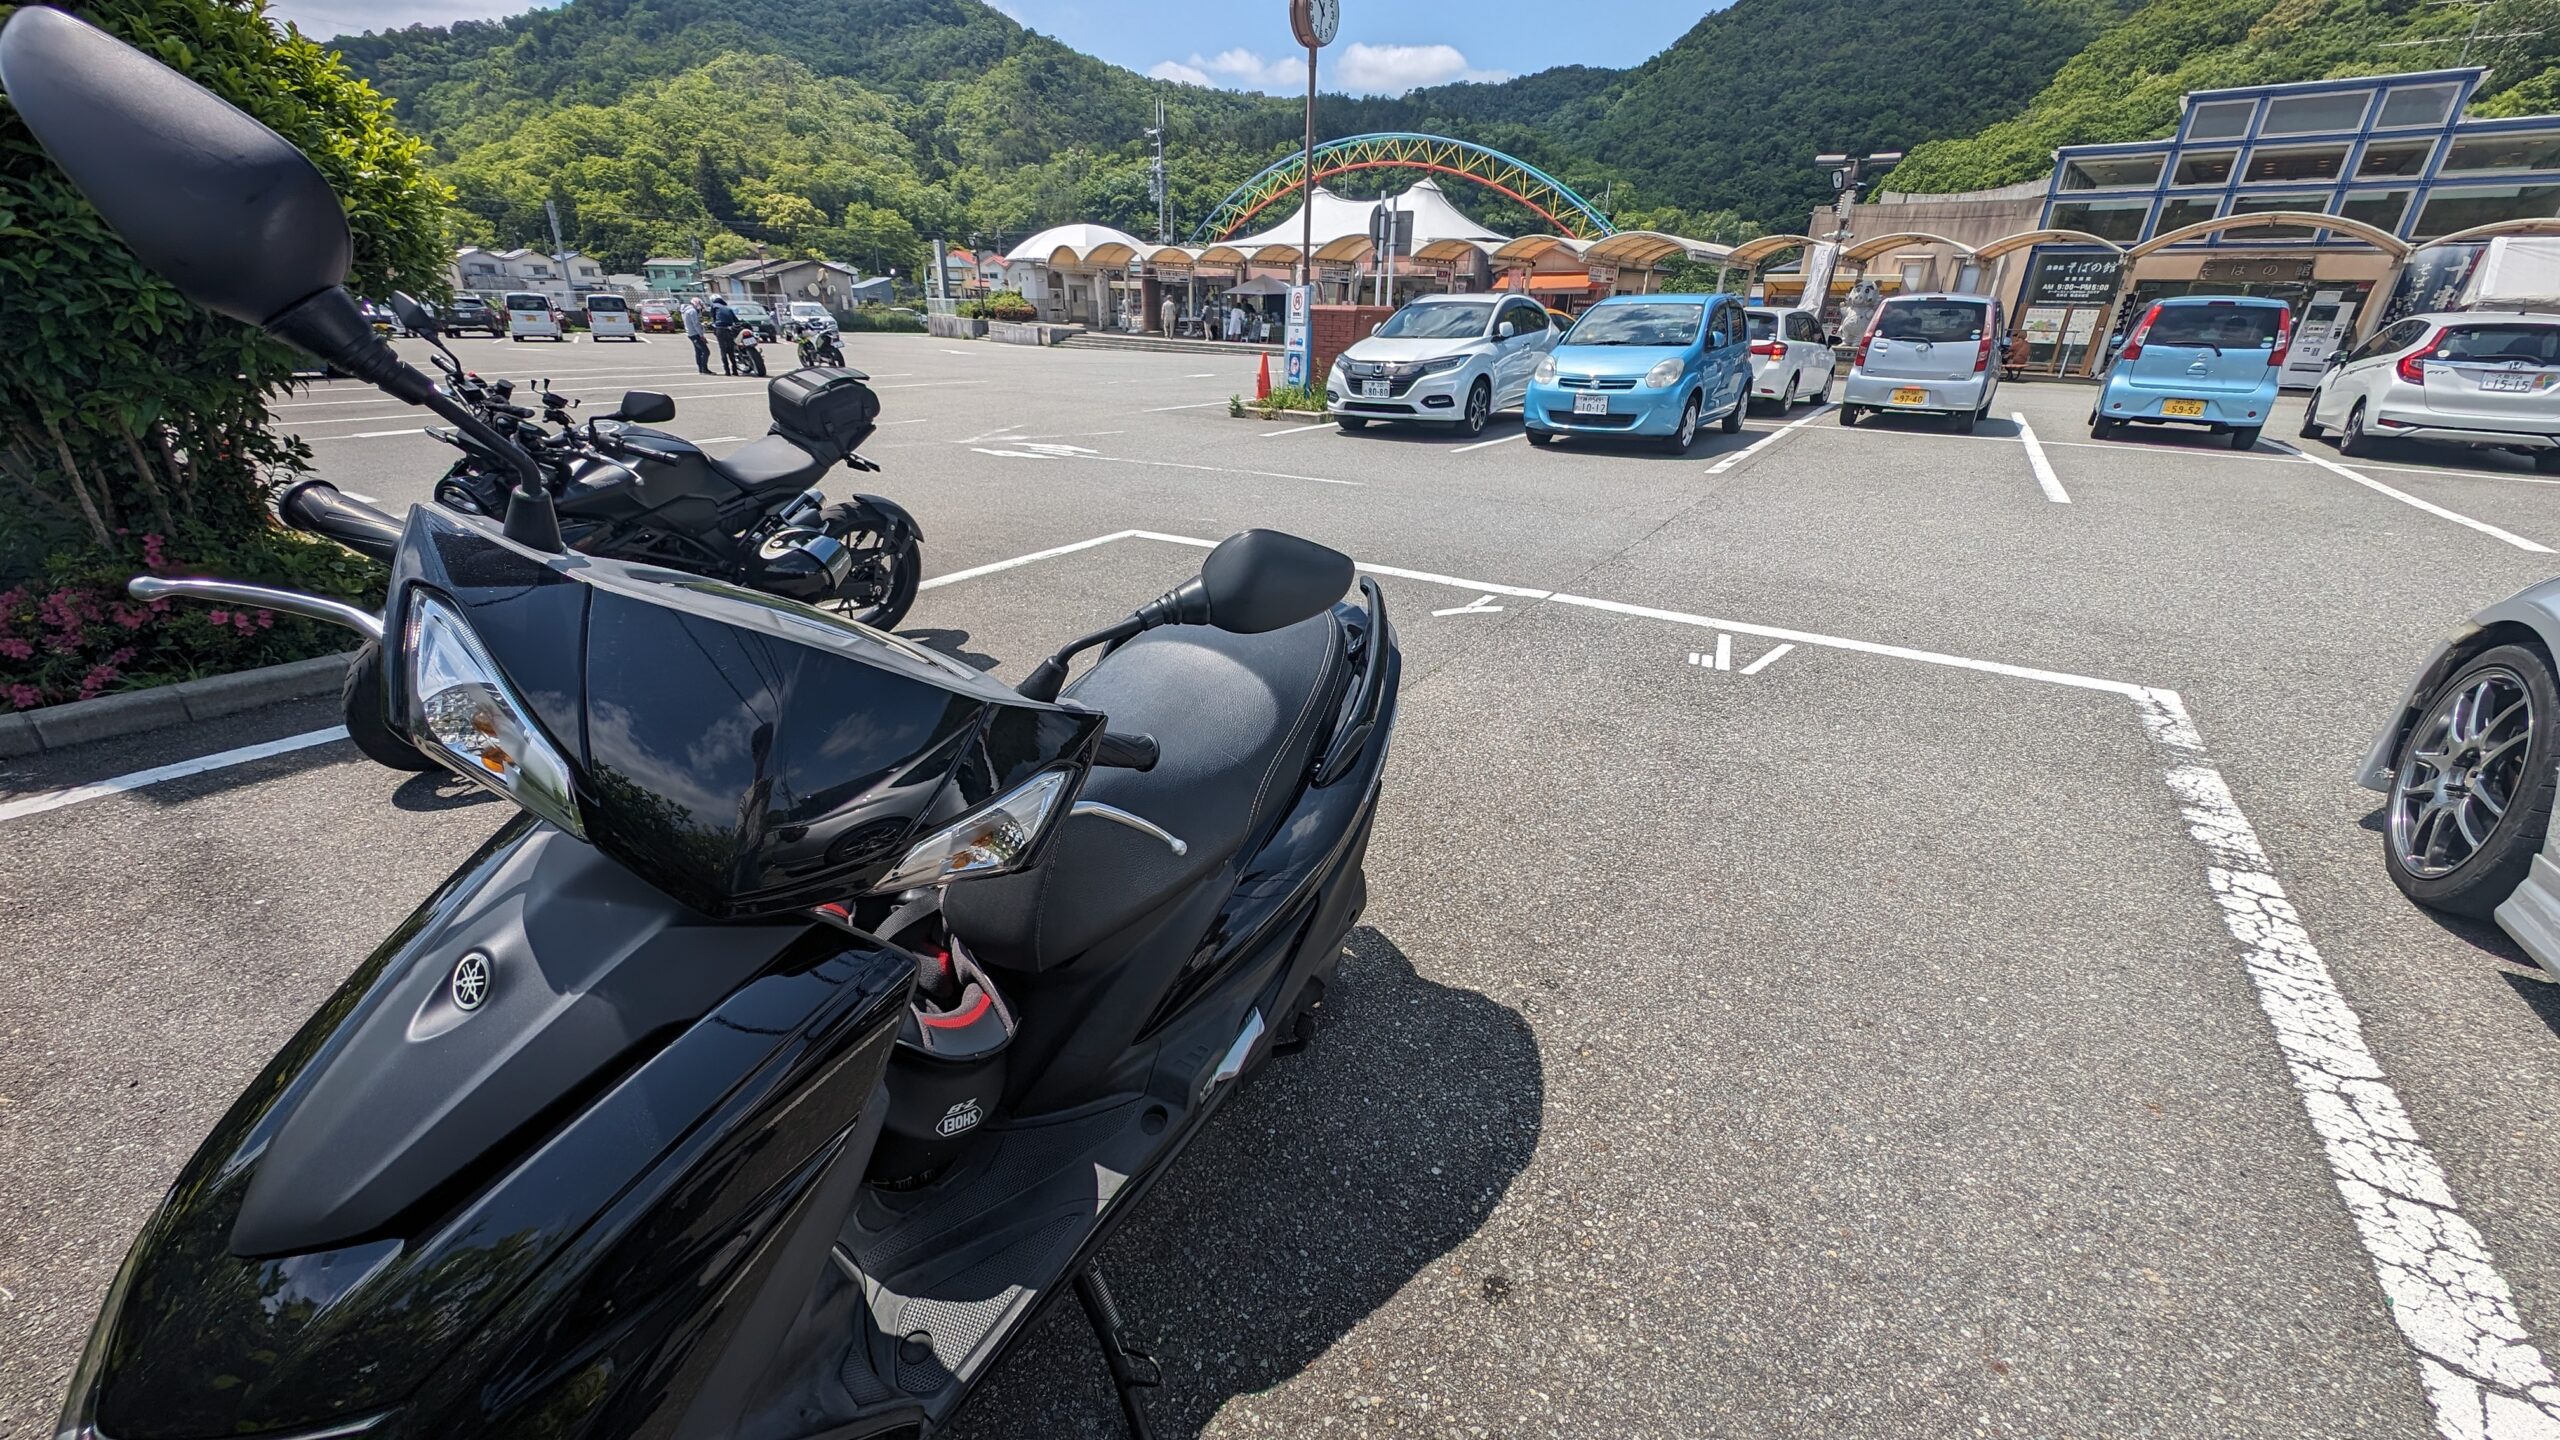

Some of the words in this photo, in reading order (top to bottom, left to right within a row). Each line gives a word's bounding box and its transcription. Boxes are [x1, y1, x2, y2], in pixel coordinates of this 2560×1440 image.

[2066, 261, 2117, 274] そばの館
[2493, 379, 2531, 391] 15-15
[1368, 387, 1388, 397] 80-80
[1899, 394, 1923, 404] 97-40
[1582, 403, 1606, 413] 10-12
[2171, 405, 2201, 415] 59-52
[943, 1109, 977, 1133] SHOEI
